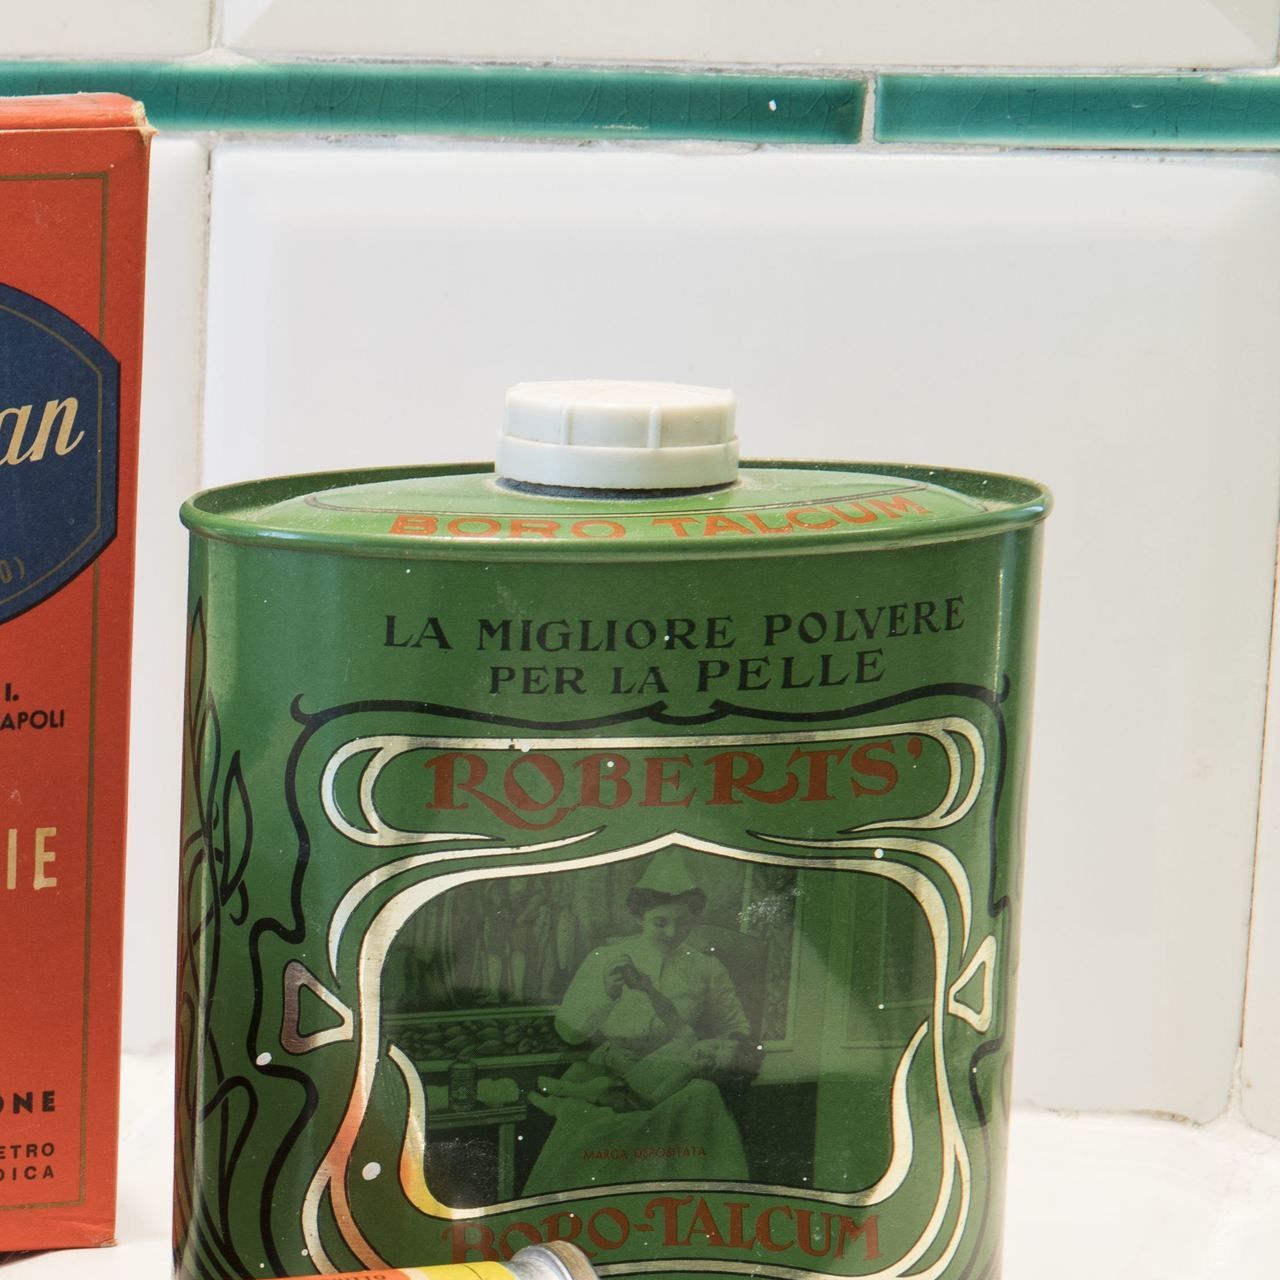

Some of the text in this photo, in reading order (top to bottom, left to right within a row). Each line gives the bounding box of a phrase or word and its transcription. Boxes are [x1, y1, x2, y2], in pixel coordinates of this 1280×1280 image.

[388, 490, 933, 541] BORO TALCUM
[384, 595, 965, 653] LA MIGLIORE POLVERE
[488, 648, 887, 697] PER LA PELLE
[583, 1148, 628, 1162] MARCA
